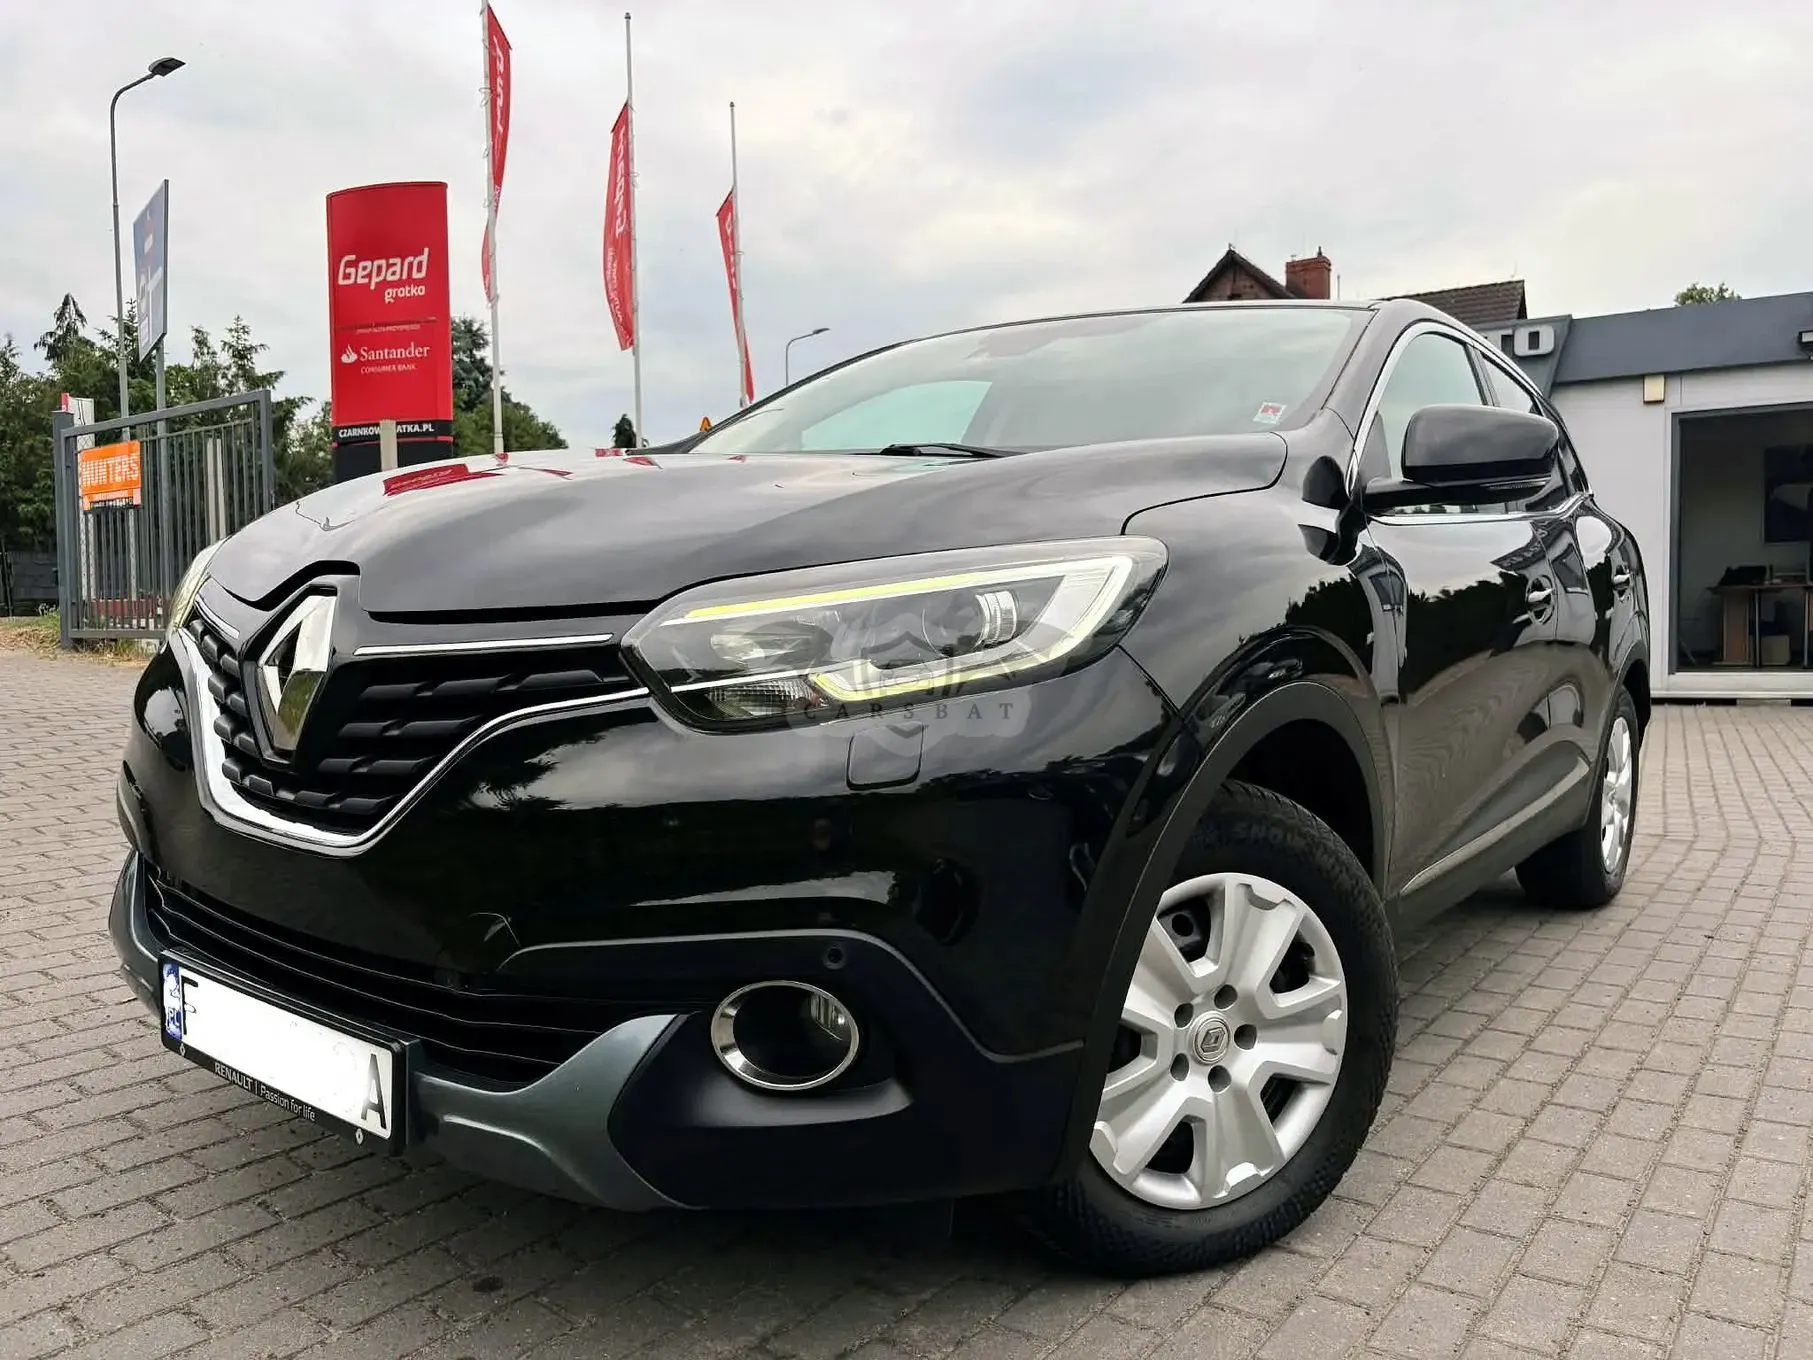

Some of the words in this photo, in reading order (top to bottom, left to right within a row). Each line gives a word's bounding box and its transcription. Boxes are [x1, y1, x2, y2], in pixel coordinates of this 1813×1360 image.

[338, 247, 429, 290] Gepard
[384, 284, 426, 304] gratka
[360, 341, 430, 361] Santander
[360, 364, 397, 375] CONSUMER
[397, 363, 417, 372] BANK
[214, 1061, 254, 1091] RENAULT
[260, 1084, 290, 1110] Passion
[290, 1099, 302, 1116] for
[303, 1104, 316, 1122] life
[360, 1053, 387, 1130] A
